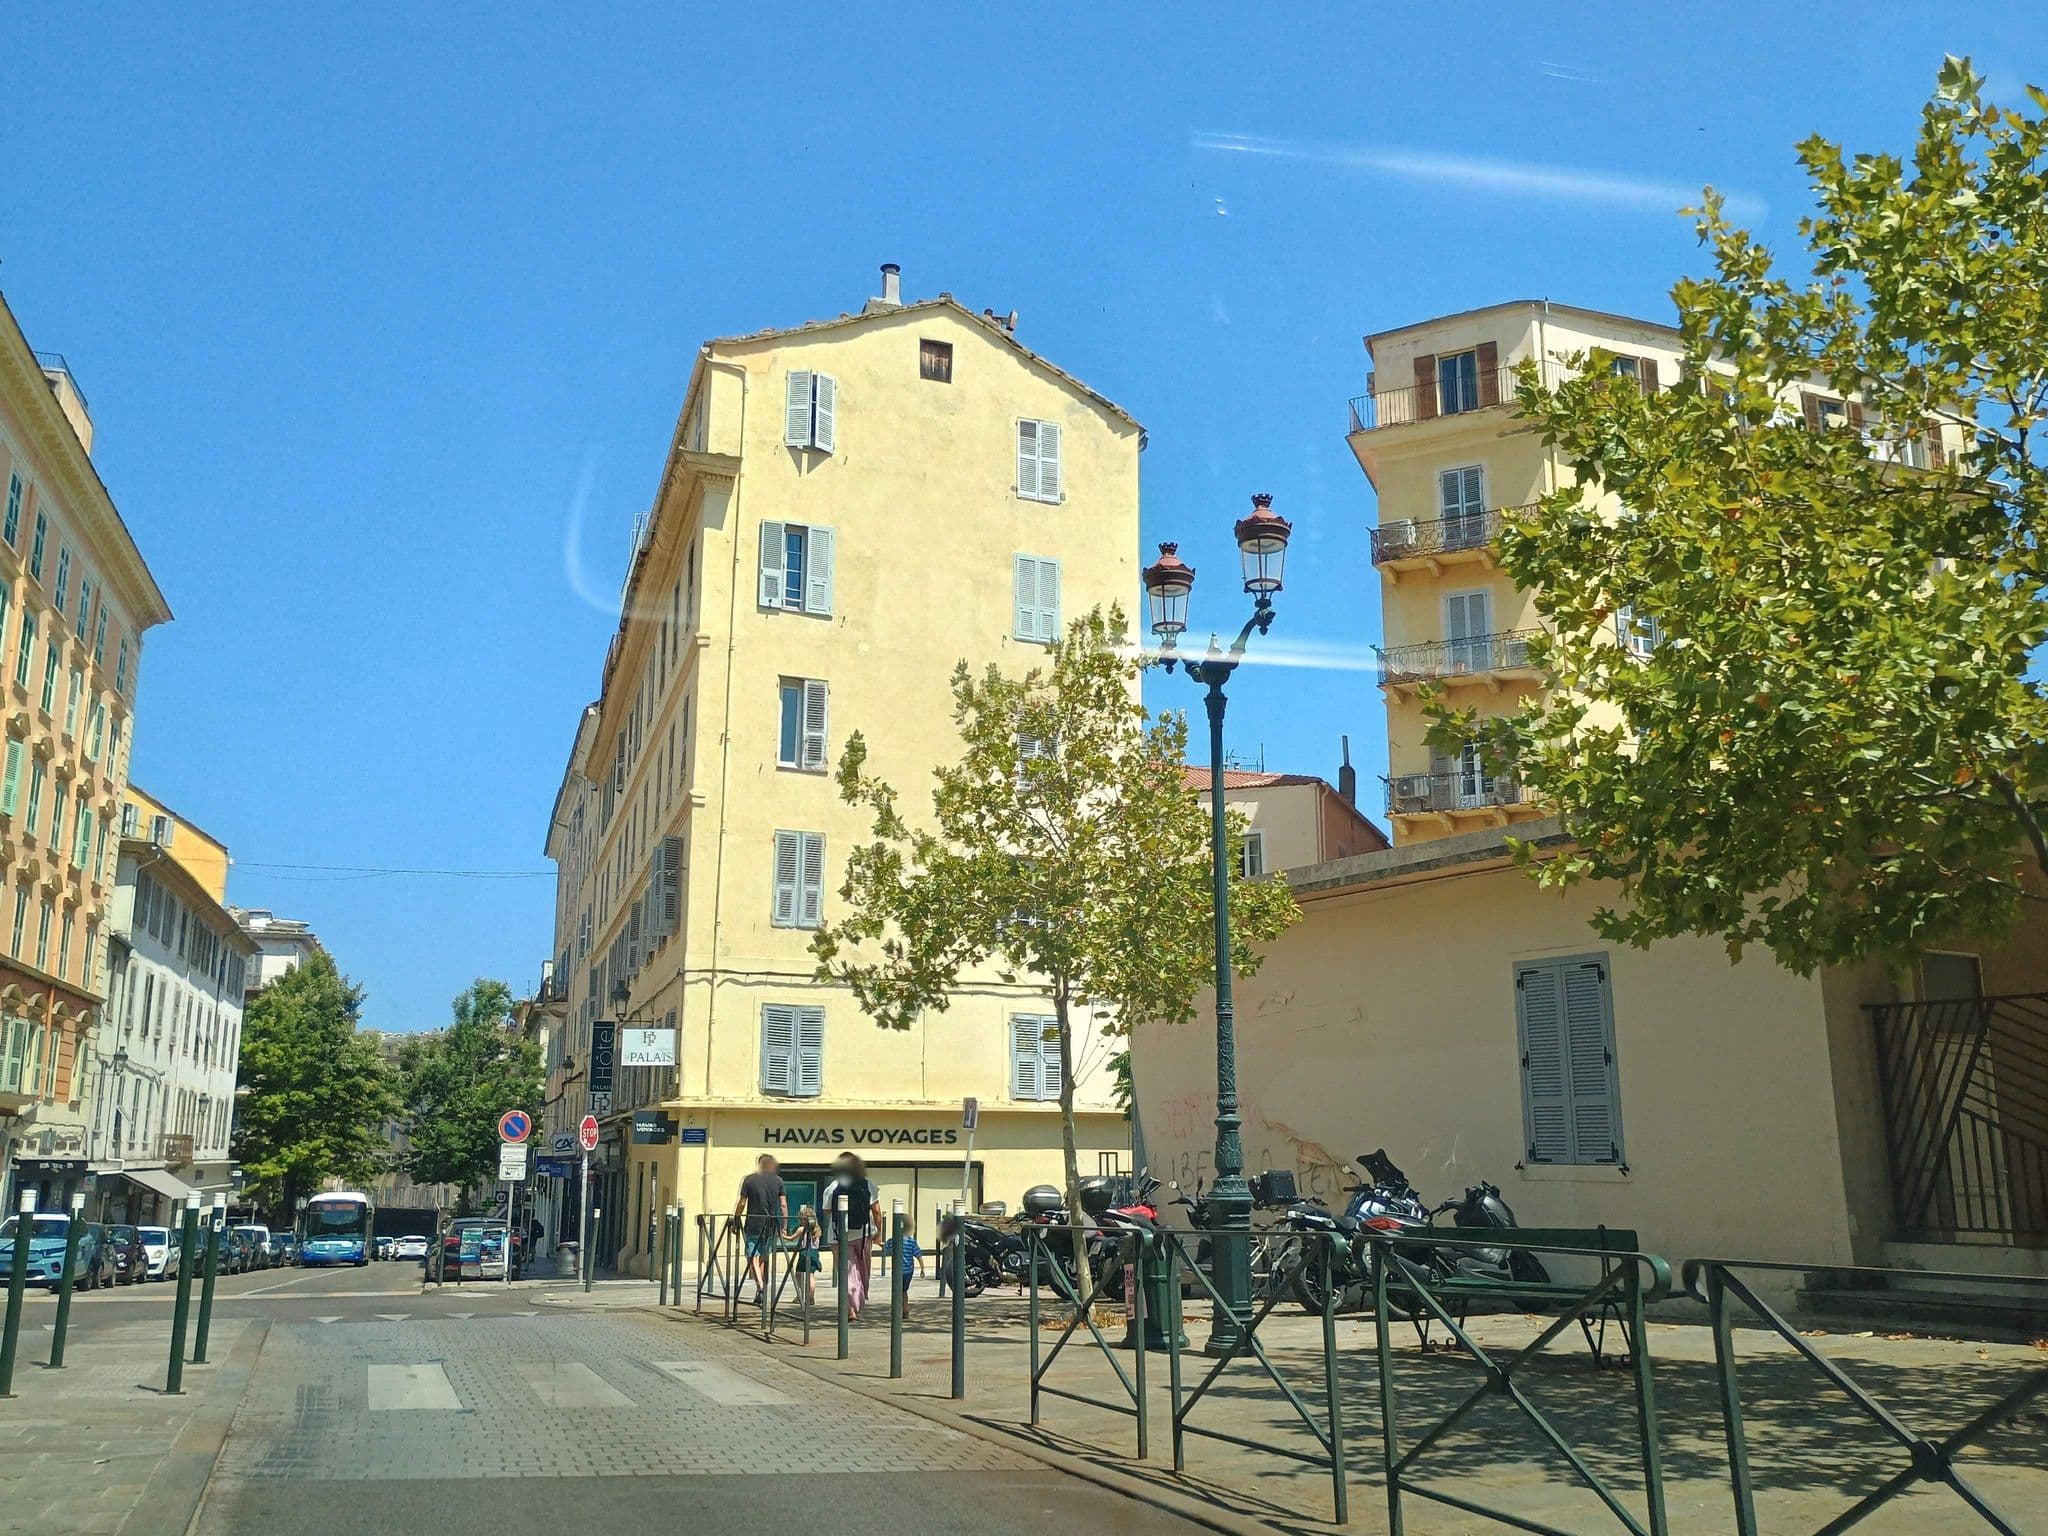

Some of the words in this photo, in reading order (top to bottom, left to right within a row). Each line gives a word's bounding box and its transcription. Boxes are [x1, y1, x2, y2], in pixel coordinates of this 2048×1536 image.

[593, 1026, 614, 1079] Hôtel
[630, 1052, 674, 1063] PALAIS
[582, 1128, 597, 1138] STOP
[763, 1128, 845, 1144] HAVAS
[850, 1128, 958, 1144] VOYAGES
